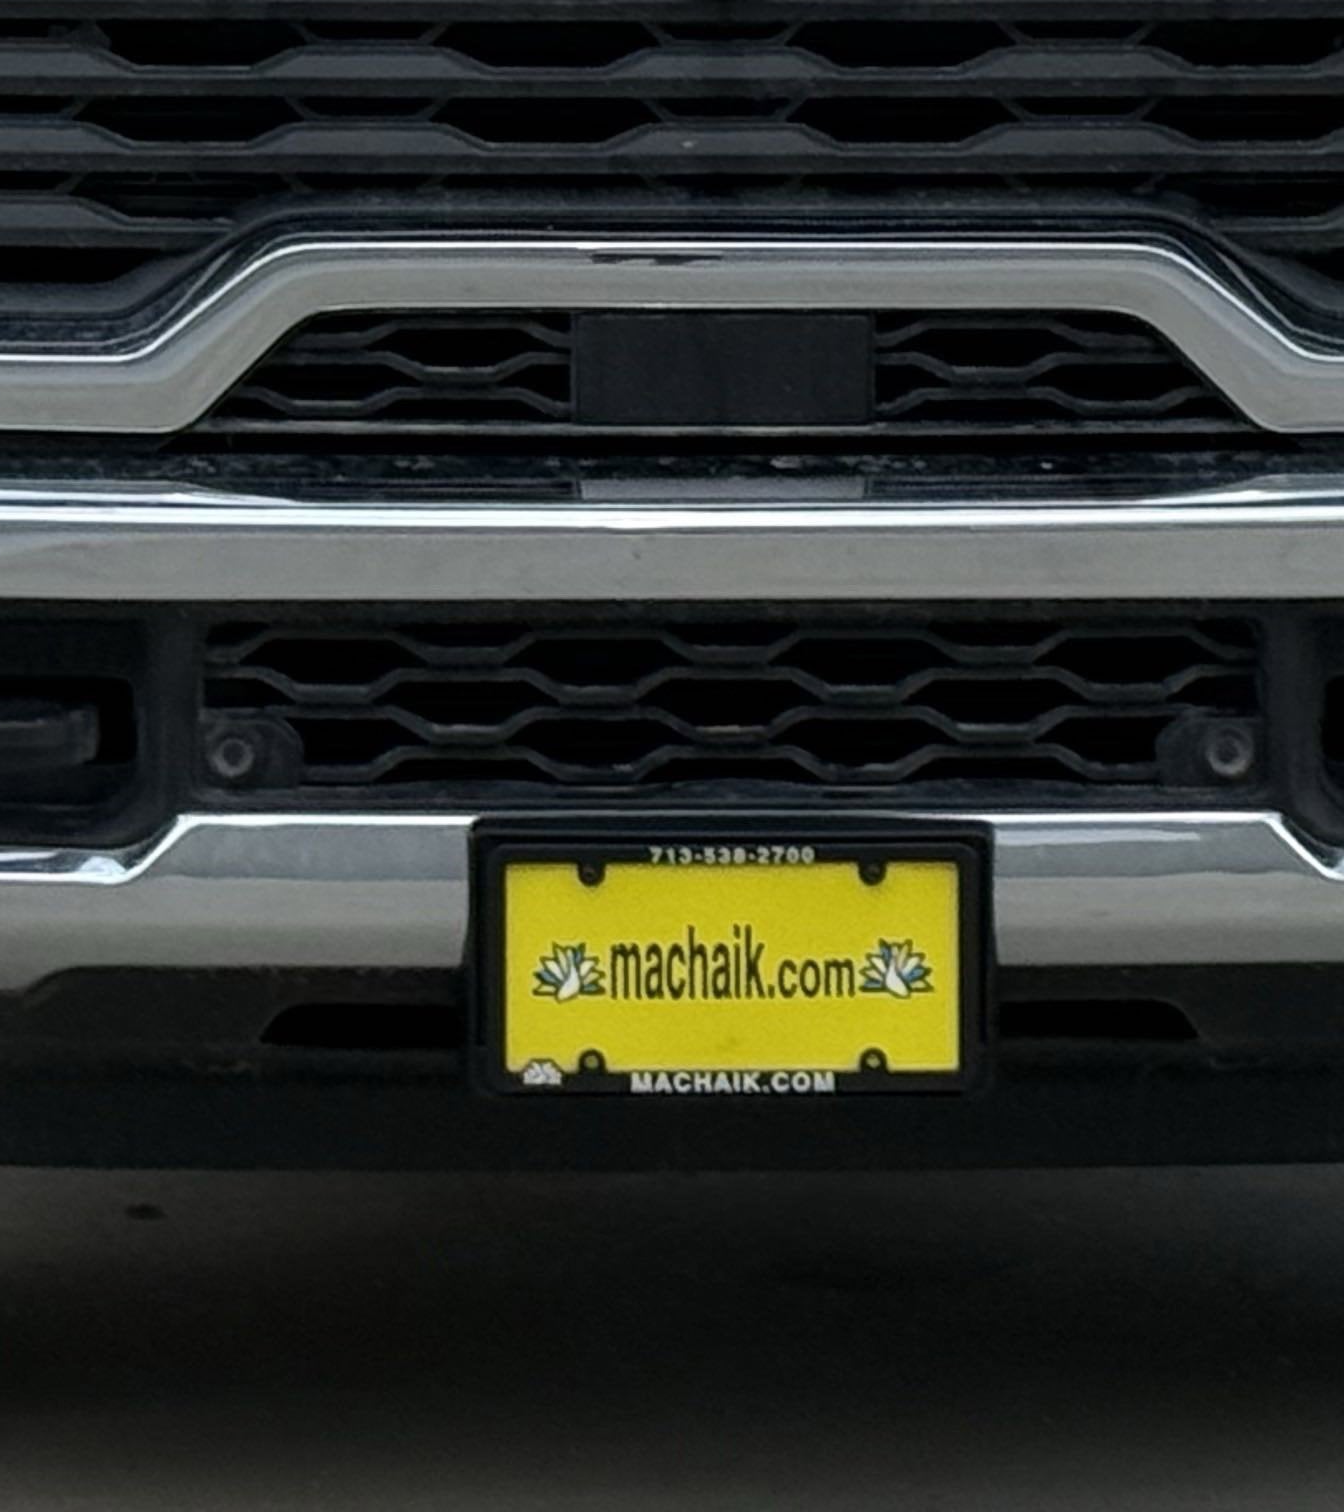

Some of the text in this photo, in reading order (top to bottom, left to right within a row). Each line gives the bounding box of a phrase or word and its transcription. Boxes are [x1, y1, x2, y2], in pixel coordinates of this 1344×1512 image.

[648, 845, 816, 865] 713-538-2700
[609, 923, 856, 1000] machaik.com
[630, 1071, 836, 1094] MACHAIK.COM
